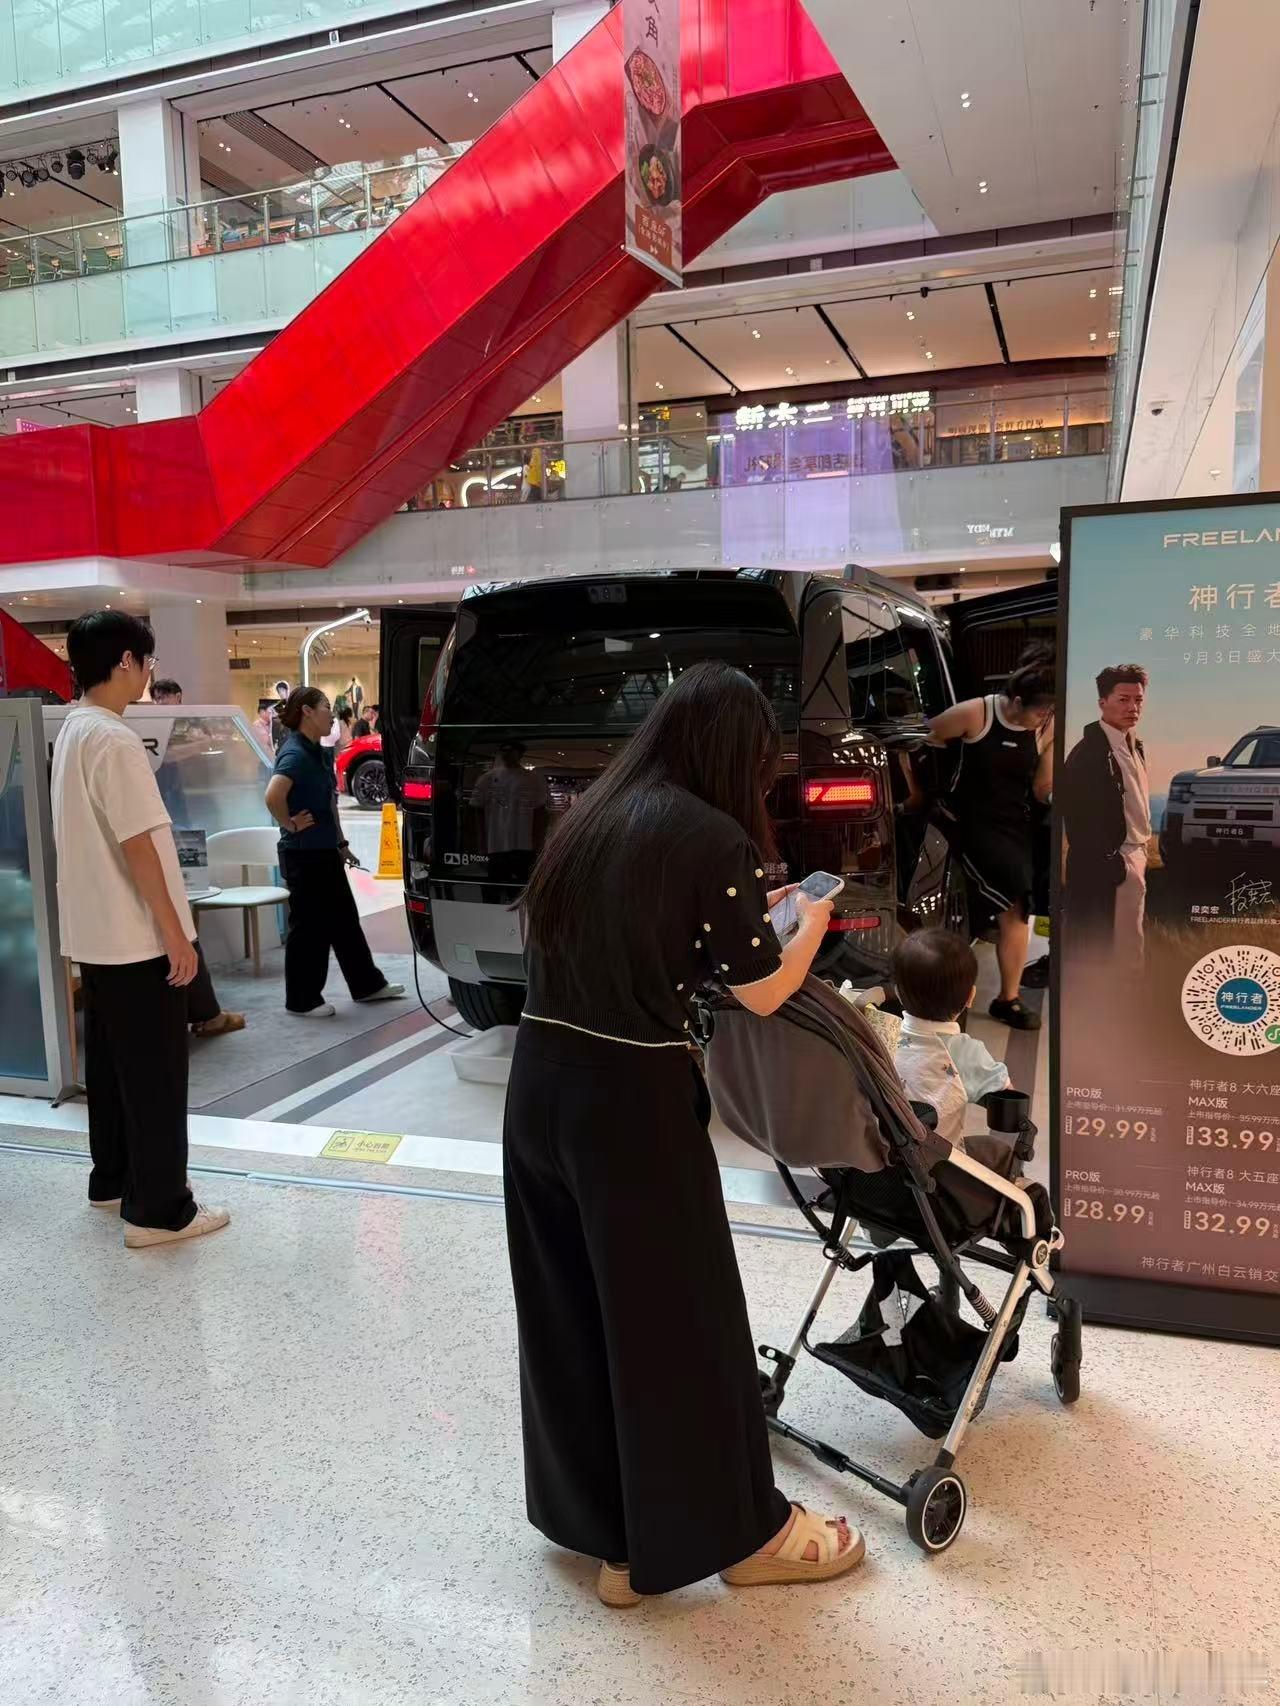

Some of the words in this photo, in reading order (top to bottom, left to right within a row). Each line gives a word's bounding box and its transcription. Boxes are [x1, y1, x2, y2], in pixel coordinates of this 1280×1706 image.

[1164, 528, 1280, 548] FREELA
[1189, 581, 1280, 611] 神行者
[1221, 992, 1264, 1004] 神行者
[1066, 1087, 1103, 1099] PRO版
[1190, 1079, 1238, 1093] 神行者8
[1188, 1096, 1228, 1109] MAX版
[1076, 1117, 1148, 1140] 29.99
[1198, 1126, 1274, 1151] 33.99
[1065, 1169, 1101, 1182] PRO版
[1187, 1165, 1234, 1179] 神行者8
[1239, 1170, 1280, 1184] 大五座
[1185, 1181, 1225, 1194] MAX版
[1075, 1199, 1145, 1224] 28.99
[1195, 1211, 1270, 1236] 32.99
[1141, 1256, 1279, 1282] 神行者广州白云销交
